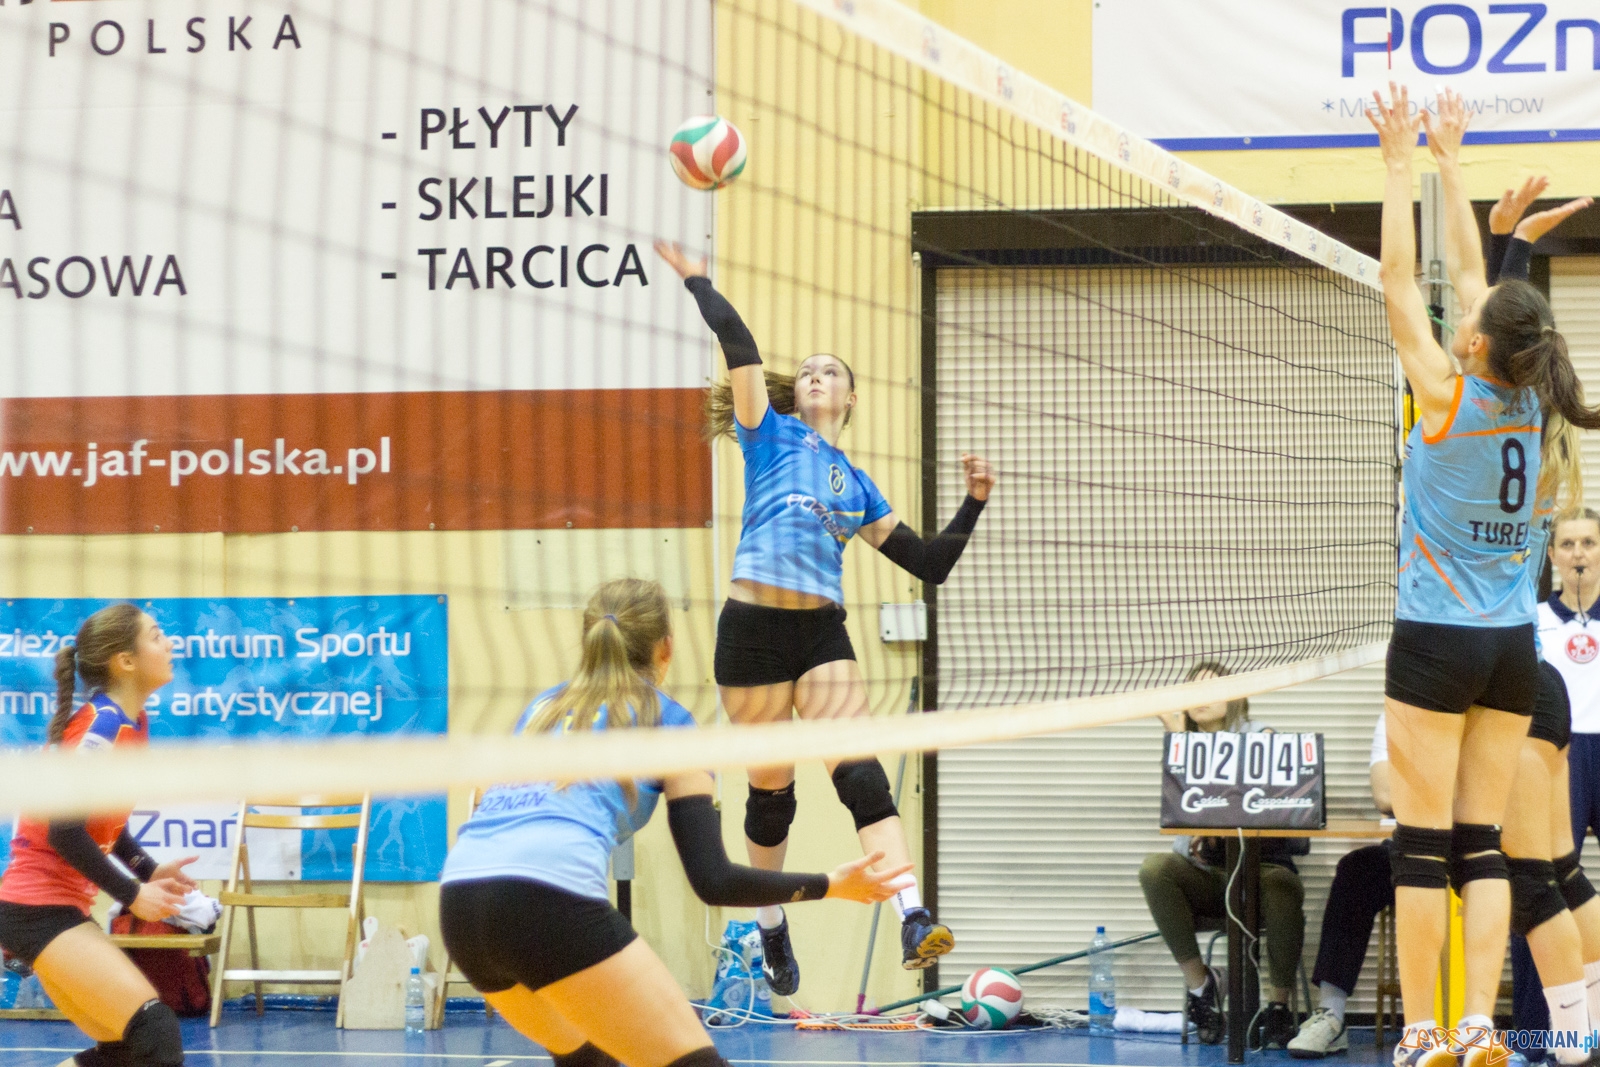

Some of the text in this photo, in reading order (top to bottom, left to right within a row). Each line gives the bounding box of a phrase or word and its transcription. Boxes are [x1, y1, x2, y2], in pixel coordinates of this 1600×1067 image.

[49, 14, 302, 57] POLSKA
[420, 104, 579, 150] PŁYTY
[418, 174, 608, 221] SKLEJKI
[0, 254, 187, 299] ASOWA
[418, 244, 648, 290] TARCICA
[1499, 437, 1526, 513] 8
[1468, 520, 1529, 546] TURE
[160, 627, 284, 659] entrum
[295, 626, 411, 663] Sportu
[171, 685, 382, 722] artystycznej
